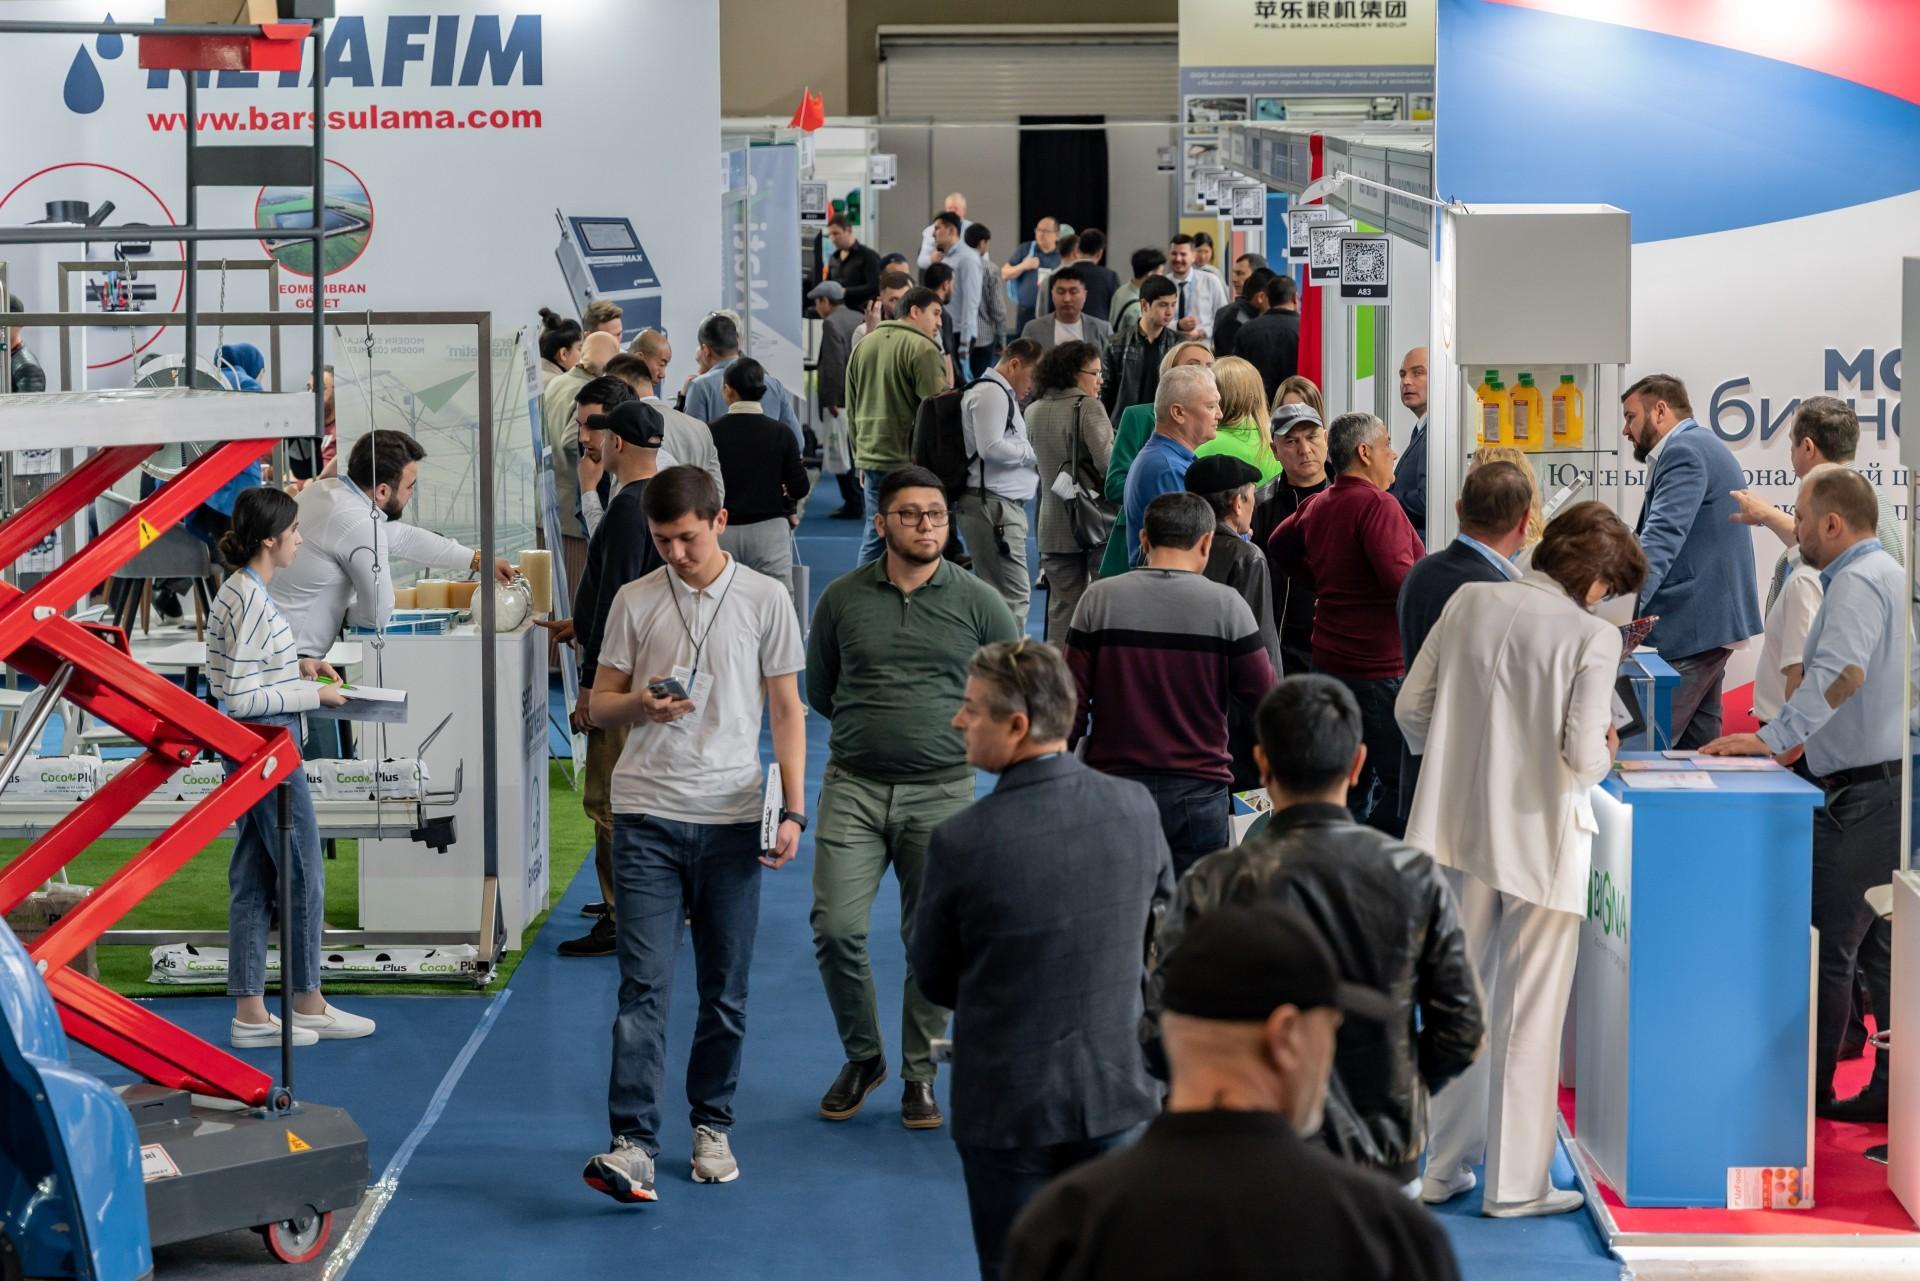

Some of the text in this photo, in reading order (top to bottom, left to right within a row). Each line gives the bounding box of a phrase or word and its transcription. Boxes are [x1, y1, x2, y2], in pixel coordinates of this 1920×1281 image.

[147, 15, 543, 89] AFIM
[1357, 288, 1372, 296] A83
[40, 771, 67, 783] Coco
[77, 771, 94, 783] Plu
[182, 773, 210, 784] Coco
[306, 773, 322, 784] lus
[336, 772, 399, 783] Coco Plus
[382, 963, 408, 972] Plus
[419, 961, 478, 972] Coco Plu
